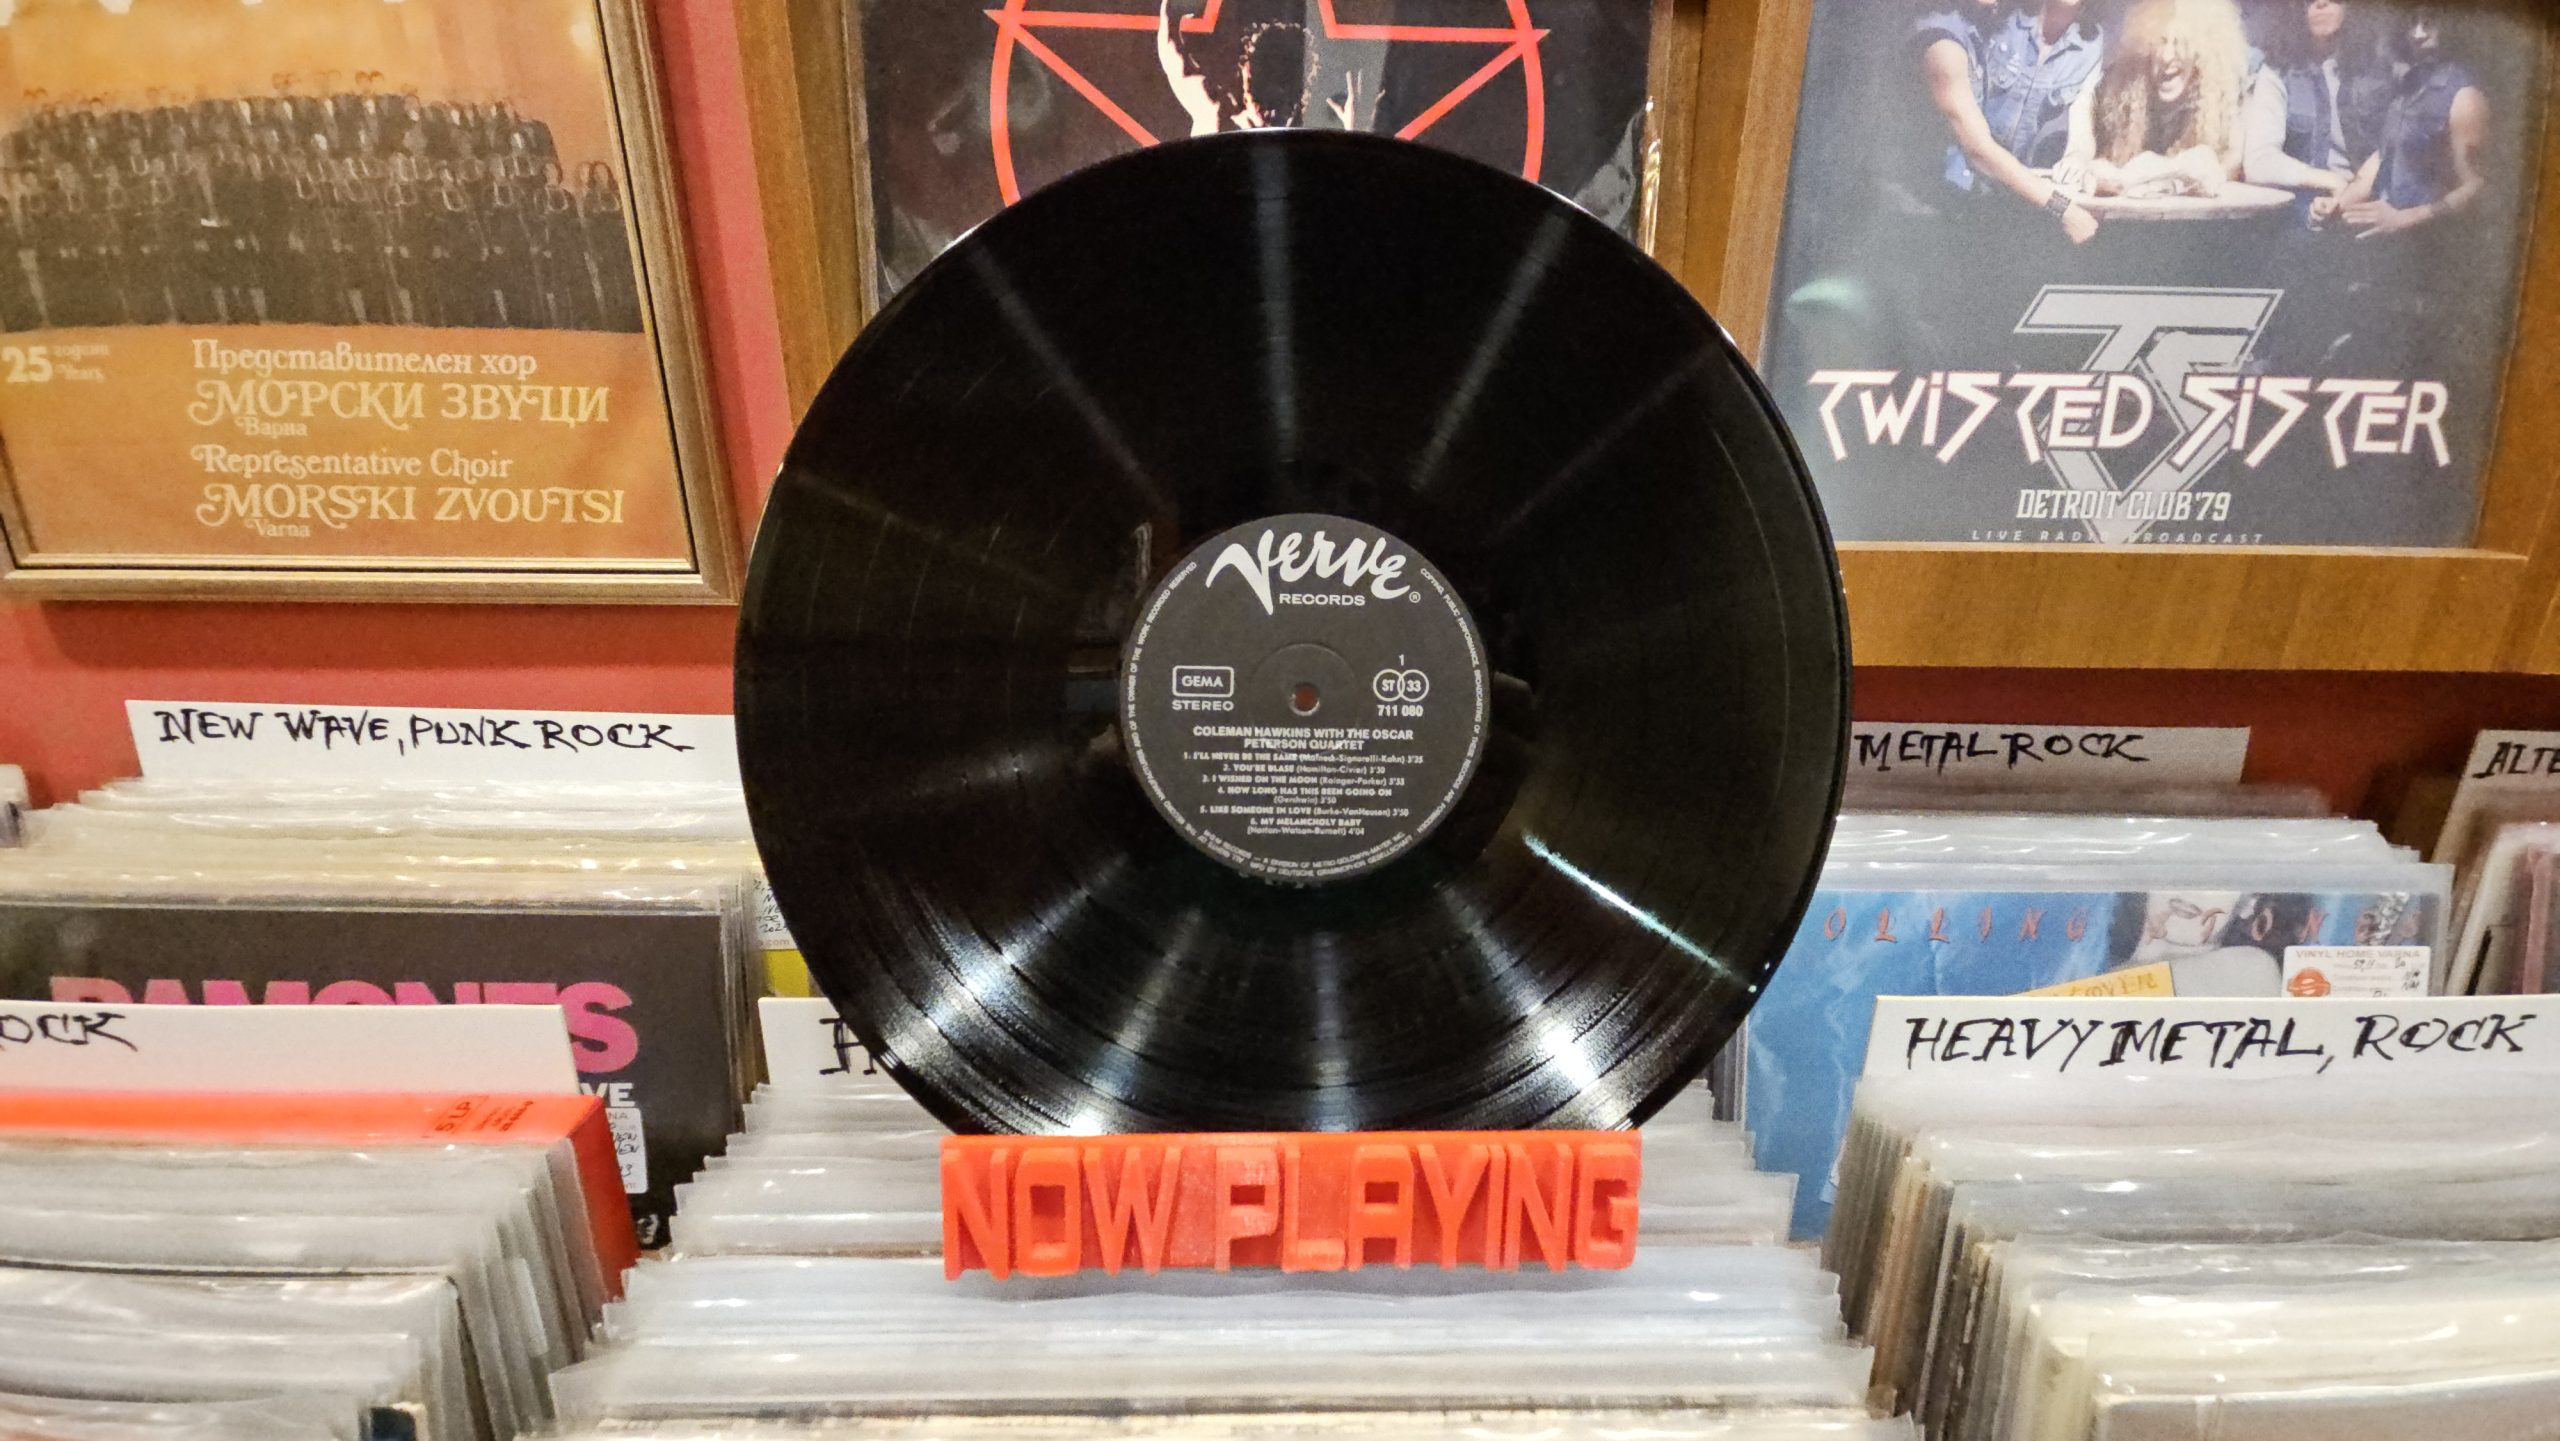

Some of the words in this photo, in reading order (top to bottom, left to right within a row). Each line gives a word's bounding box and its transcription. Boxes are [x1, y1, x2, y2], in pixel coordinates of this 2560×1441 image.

[2, 346, 53, 384] 25
[192, 339, 473, 378] Представителен
[480, 353, 538, 381] хор
[187, 379, 425, 431] МОРСКИ
[440, 382, 610, 428] ЗВУЦИ
[235, 416, 308, 439] Варна
[190, 443, 422, 479] Representative
[430, 448, 514, 484] Choir
[195, 482, 417, 529] MORSKI
[433, 486, 625, 524] ZVOUTSI
[2016, 489, 2122, 519] DETROIT
[243, 518, 311, 537] Varna
[1971, 529, 2023, 542] LIVE
[2040, 530, 2112, 543] RADIO
[2129, 531, 2264, 545] BROADCAST
[1146, 589, 1171, 623] RECORDED
[1279, 593, 1366, 607] RECORDS
[1443, 593, 1460, 617] PUBLIC
[1137, 623, 1151, 645] WORK
[1131, 647, 1143, 661] THE
[1399, 654, 1405, 666] 1
[1130, 662, 1138, 673] OF
[1181, 675, 1224, 688] GEMA
[1381, 680, 1396, 692] ST
[1406, 681, 1421, 693] 33
[1474, 669, 1484, 722] BROADCASTING
[1171, 700, 1235, 712] STEREO
[1377, 705, 1398, 717] 711
[154, 709, 264, 743] NEW
[410, 714, 532, 750] PUNK
[532, 718, 696, 754] ROCK
[1193, 726, 1252, 737] COLEMAN
[1254, 727, 1311, 738] HAWKINS
[1314, 728, 1344, 739] WITH
[1346, 729, 1370, 739] THE
[1372, 729, 1414, 740] OSCAR
[1244, 738, 1307, 749] PETERSON
[1309, 740, 1365, 750] QUARTET
[1854, 730, 1998, 776] METAL
[2000, 732, 2151, 769] ROCK
[1211, 752, 1240, 760] NEVER
[1255, 753, 1271, 761] THE
[1218, 775, 1253, 783] WISHED
[1254, 775, 1269, 783] ON
[1271, 776, 1287, 784] THE
[1288, 776, 1318, 784] MOON
[1452, 758, 1472, 789] RECORDS
[1280, 787, 1298, 795] HAS
[1300, 787, 1320, 796] THIS
[1321, 788, 1343, 796] BEEN
[1378, 788, 1393, 797] ON
[1230, 805, 1274, 815] SOMEONE
[1288, 806, 1312, 815] LOVE
[1260, 818, 1275, 826] MY
[1276, 818, 1336, 827] MELANCHOLY
[1823, 906, 2089, 943] OLLING
[2295, 950, 2333, 959] VINYL
[0, 1012, 138, 1052] OCK
[1905, 1016, 2101, 1072] HEAVY
[2351, 1014, 2539, 1060] ROCK
[940, 1144, 1182, 1280] NOW
[1213, 1142, 1642, 1273] PLAYING
